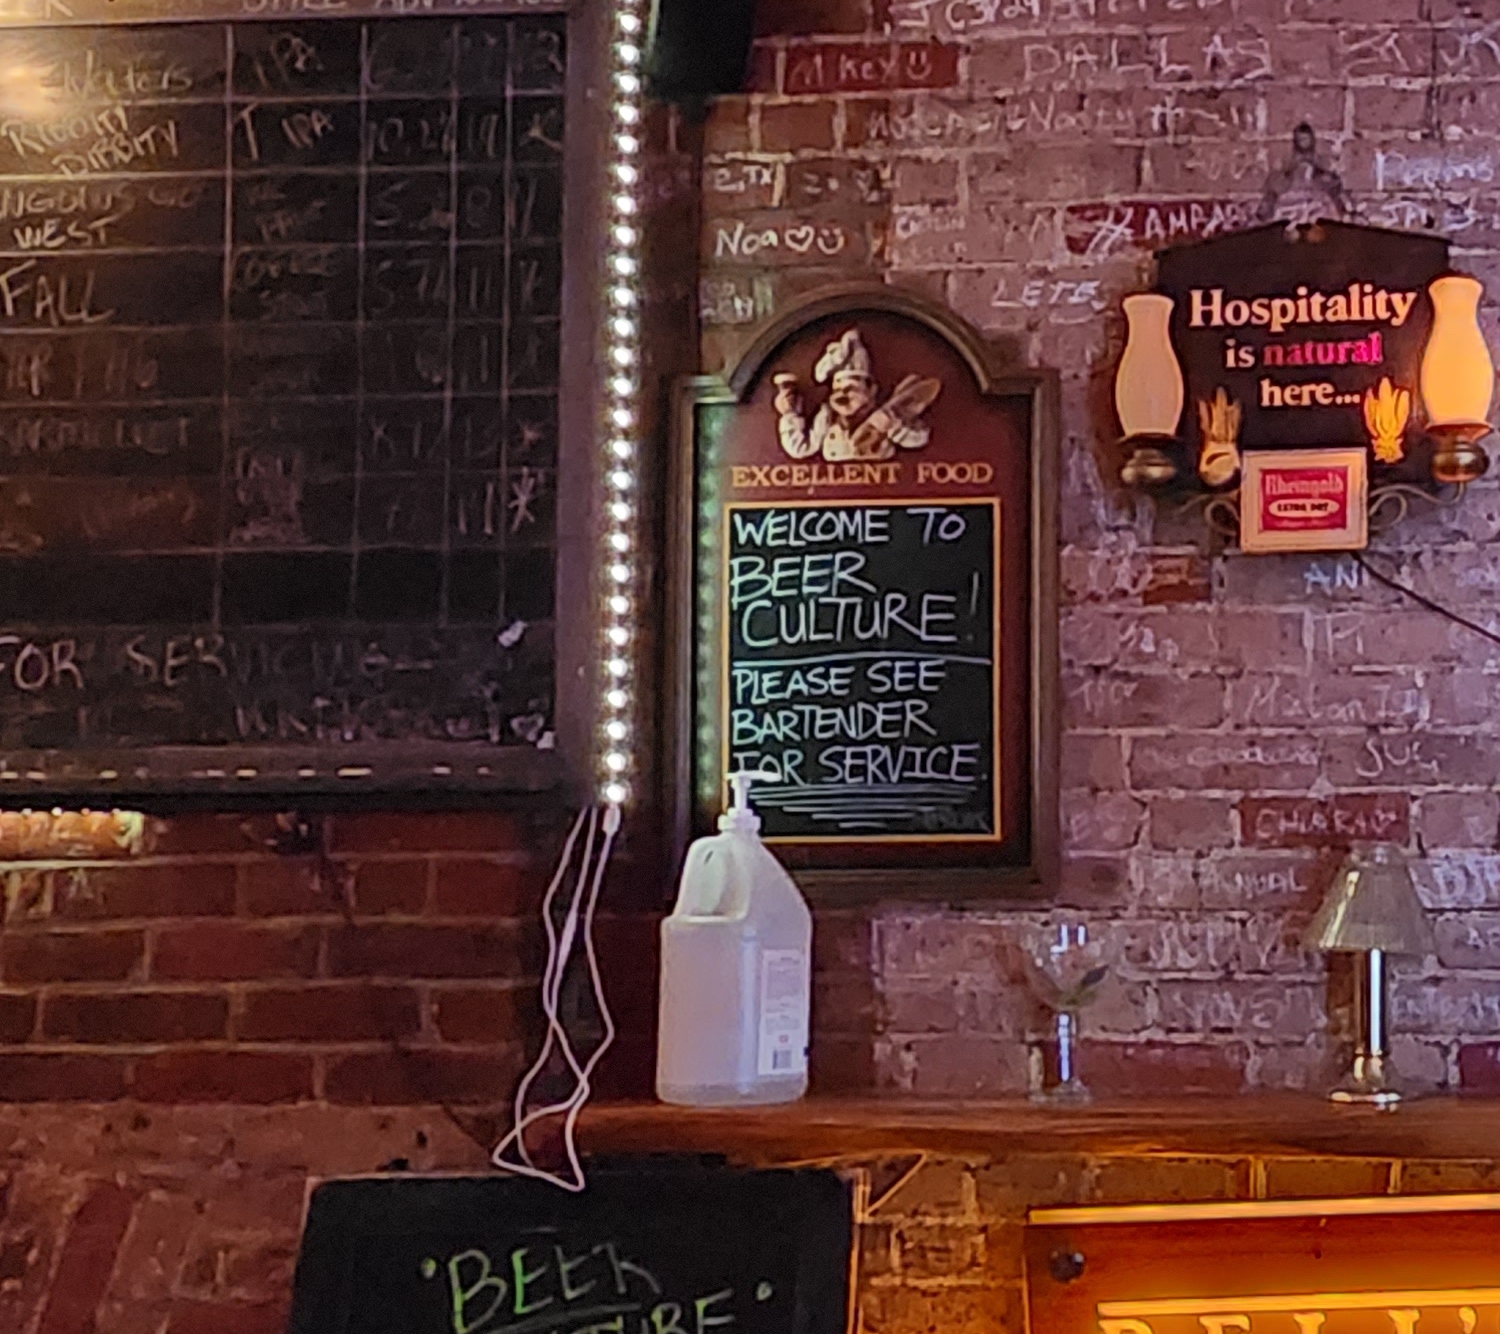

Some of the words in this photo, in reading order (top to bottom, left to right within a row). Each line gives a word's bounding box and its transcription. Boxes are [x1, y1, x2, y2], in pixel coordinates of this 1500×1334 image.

[14, 216, 116, 249] WEST
[1188, 283, 1418, 332] Hospitality
[1225, 338, 1255, 368] is
[1262, 332, 1384, 366] natural
[1260, 378, 1362, 409] here...
[731, 463, 902, 489] EXCELLENT
[916, 462, 994, 485] FOOD
[732, 510, 890, 548] WELCOME
[906, 508, 966, 542] TO
[731, 552, 877, 610] BEER
[732, 667, 851, 705] PLEASE
[866, 660, 947, 694] SEE
[732, 701, 938, 746] BARTENDER
